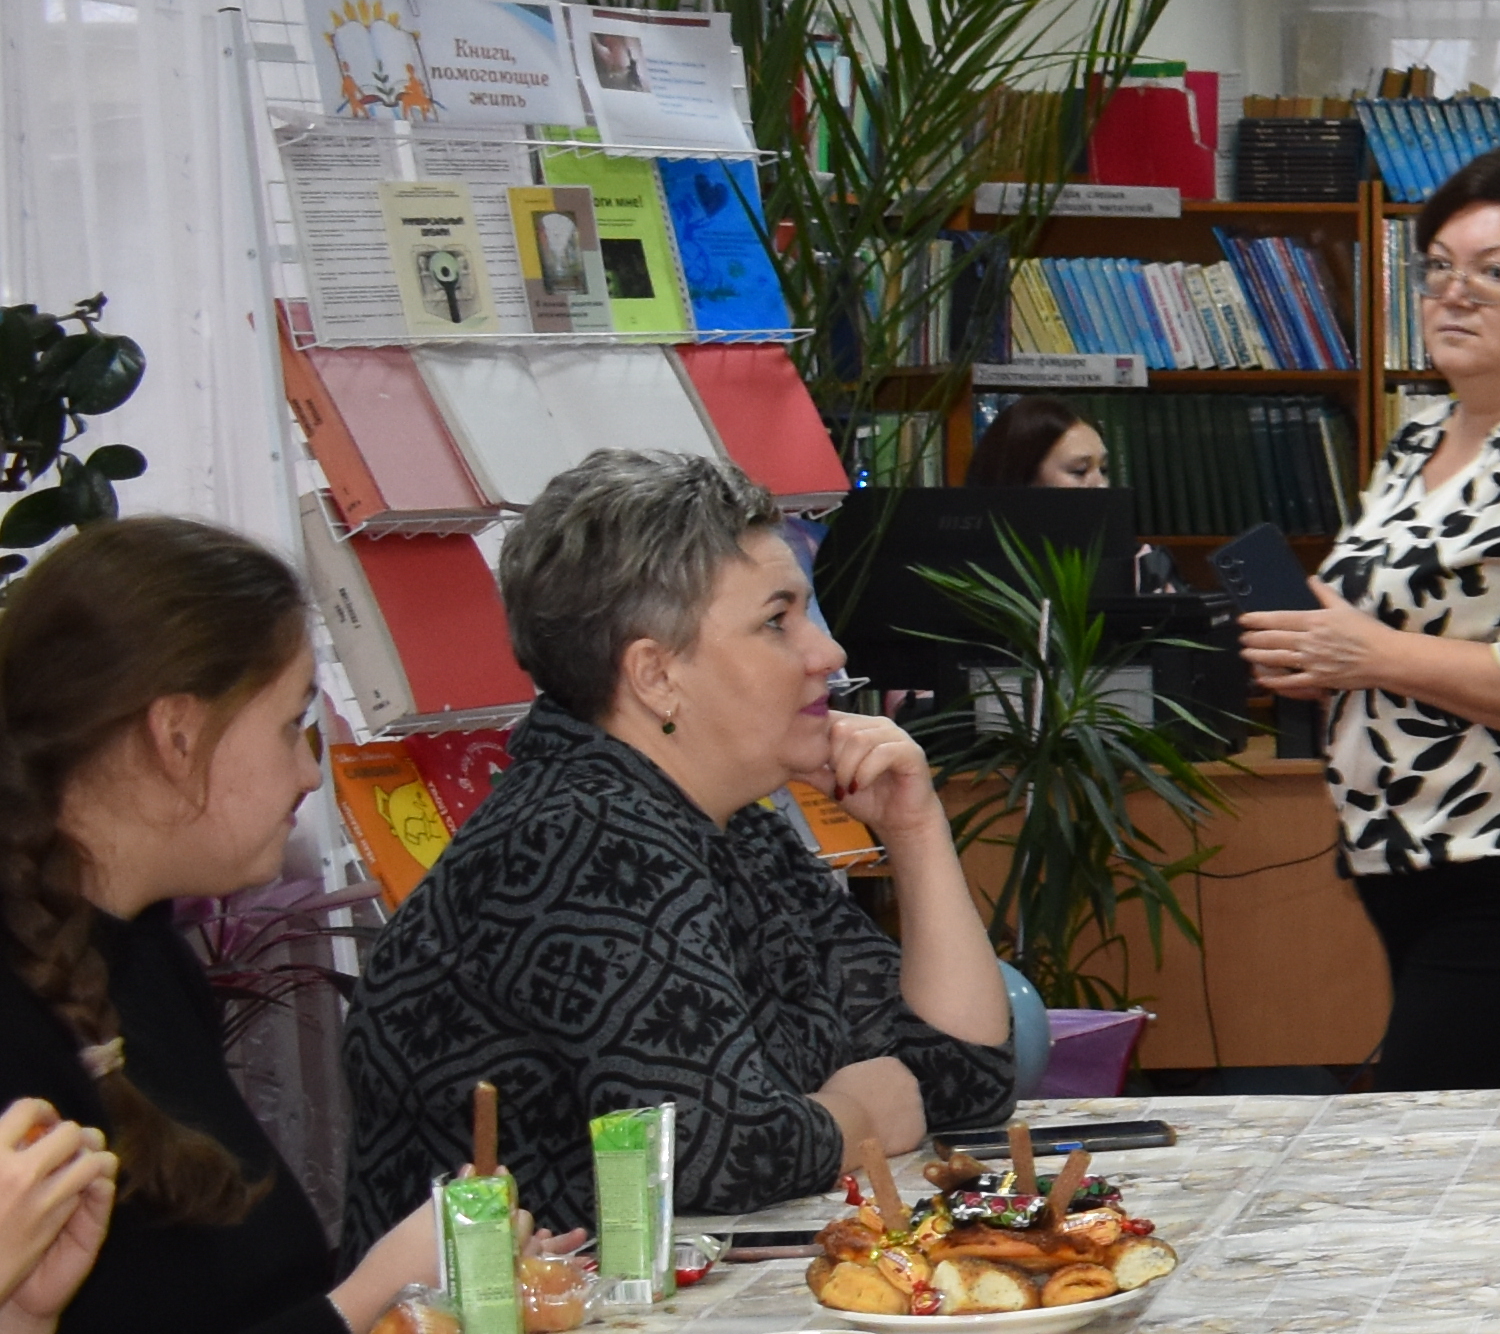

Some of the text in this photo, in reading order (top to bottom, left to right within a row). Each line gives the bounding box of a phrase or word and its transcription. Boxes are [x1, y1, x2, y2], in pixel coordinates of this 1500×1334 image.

[454, 38, 516, 65] Книги,
[431, 66, 549, 88] помогающие
[469, 90, 526, 108] жить
